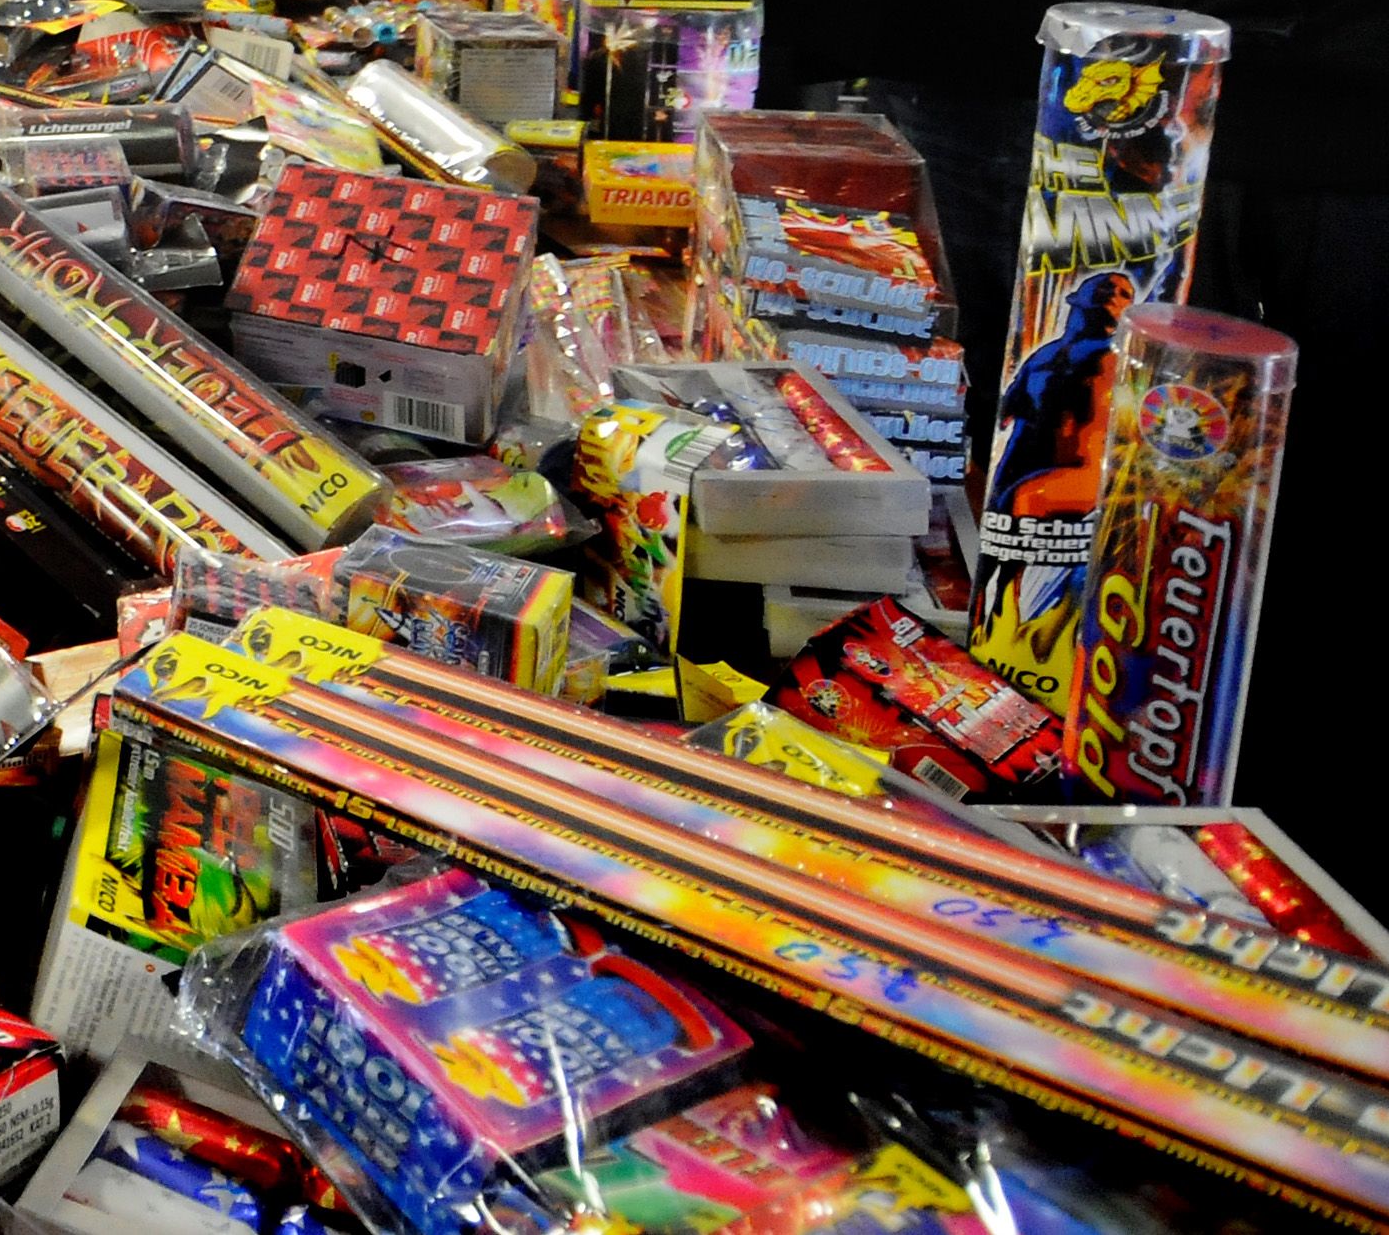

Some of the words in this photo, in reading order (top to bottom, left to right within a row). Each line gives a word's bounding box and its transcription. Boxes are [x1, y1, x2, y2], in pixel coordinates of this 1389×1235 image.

[29, 120, 133, 134] Lichterorgel
[601, 187, 693, 209] TRIANG
[1023, 186, 1203, 274] WINNE
[301, 472, 349, 516] NICO
[1019, 517, 1094, 537] Schu
[979, 541, 1089, 565] Siegesfont
[298, 633, 363, 663] NICO
[1127, 509, 1231, 807] Feuertopf
[204, 661, 270, 694] NICO
[984, 657, 1060, 695] NICO
[1077, 573, 1145, 798] Gold
[98, 871, 120, 913] NICO
